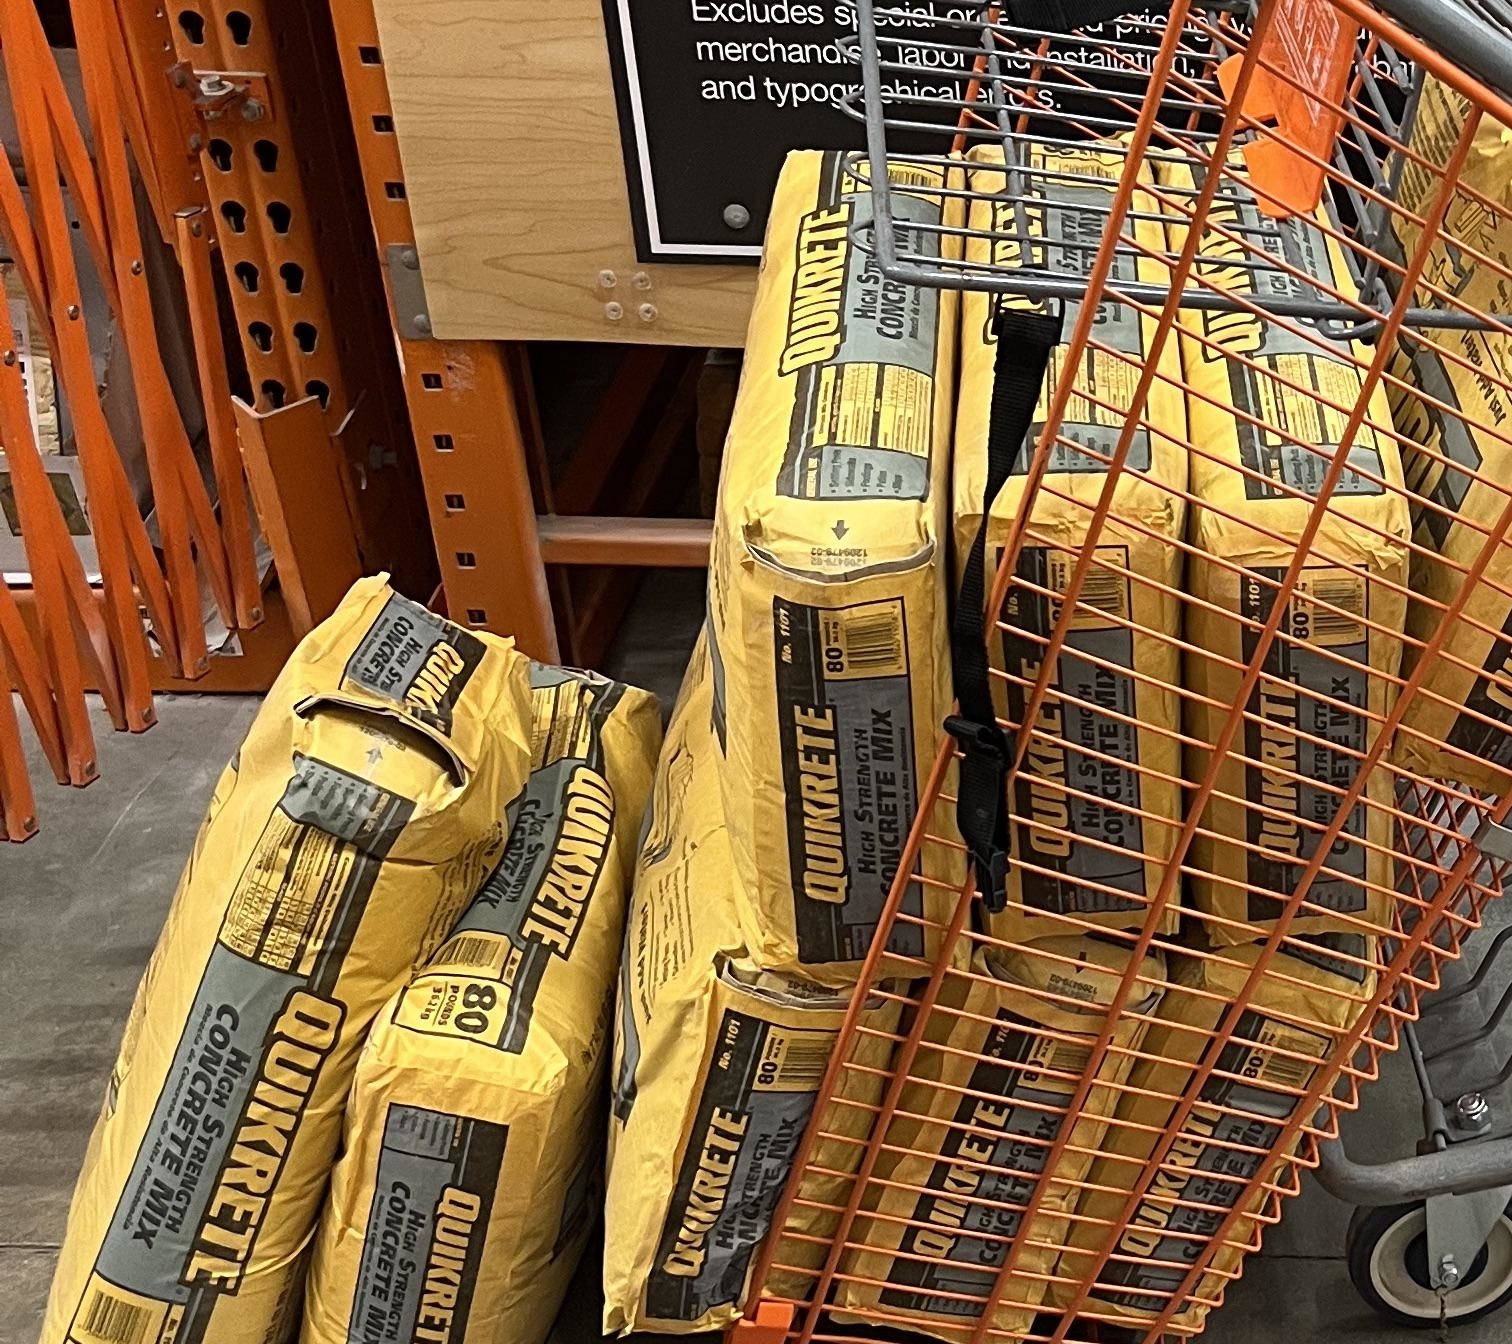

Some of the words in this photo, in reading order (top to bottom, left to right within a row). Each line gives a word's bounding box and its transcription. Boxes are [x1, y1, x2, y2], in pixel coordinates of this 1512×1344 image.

[701, 76, 756, 102] and
[763, 76, 960, 109] typogrhical
[977, 87, 1061, 109] eros.
[781, 203, 850, 376] QUIKRETE
[824, 648, 844, 673] 80
[1293, 612, 1310, 640] 80
[871, 708, 894, 759] MIX
[1022, 657, 1071, 858] QUIKREE
[1259, 676, 1299, 862] QUIKRETE
[794, 705, 849, 904] QUIKRETE
[854, 728, 875, 823] STRENGTH
[522, 767, 614, 956] QUIKRETE
[857, 827, 876, 875] HIGH
[454, 983, 497, 1034] 80
[160, 1004, 240, 1177] CONCRETE
[211, 1046, 252, 1109] HIGH
[758, 1062, 779, 1086] 80
[1245, 1055, 1264, 1078] 80
[172, 1113, 226, 1234] STRENGTH
[186, 991, 343, 1291] QUIKRETE
[767, 1117, 798, 1159] MIX
[132, 1178, 176, 1250] MIX
[371, 1180, 410, 1304] CONCRETE
[402, 1208, 426, 1254] HIGH
[385, 1258, 416, 1341] STRENGTH
